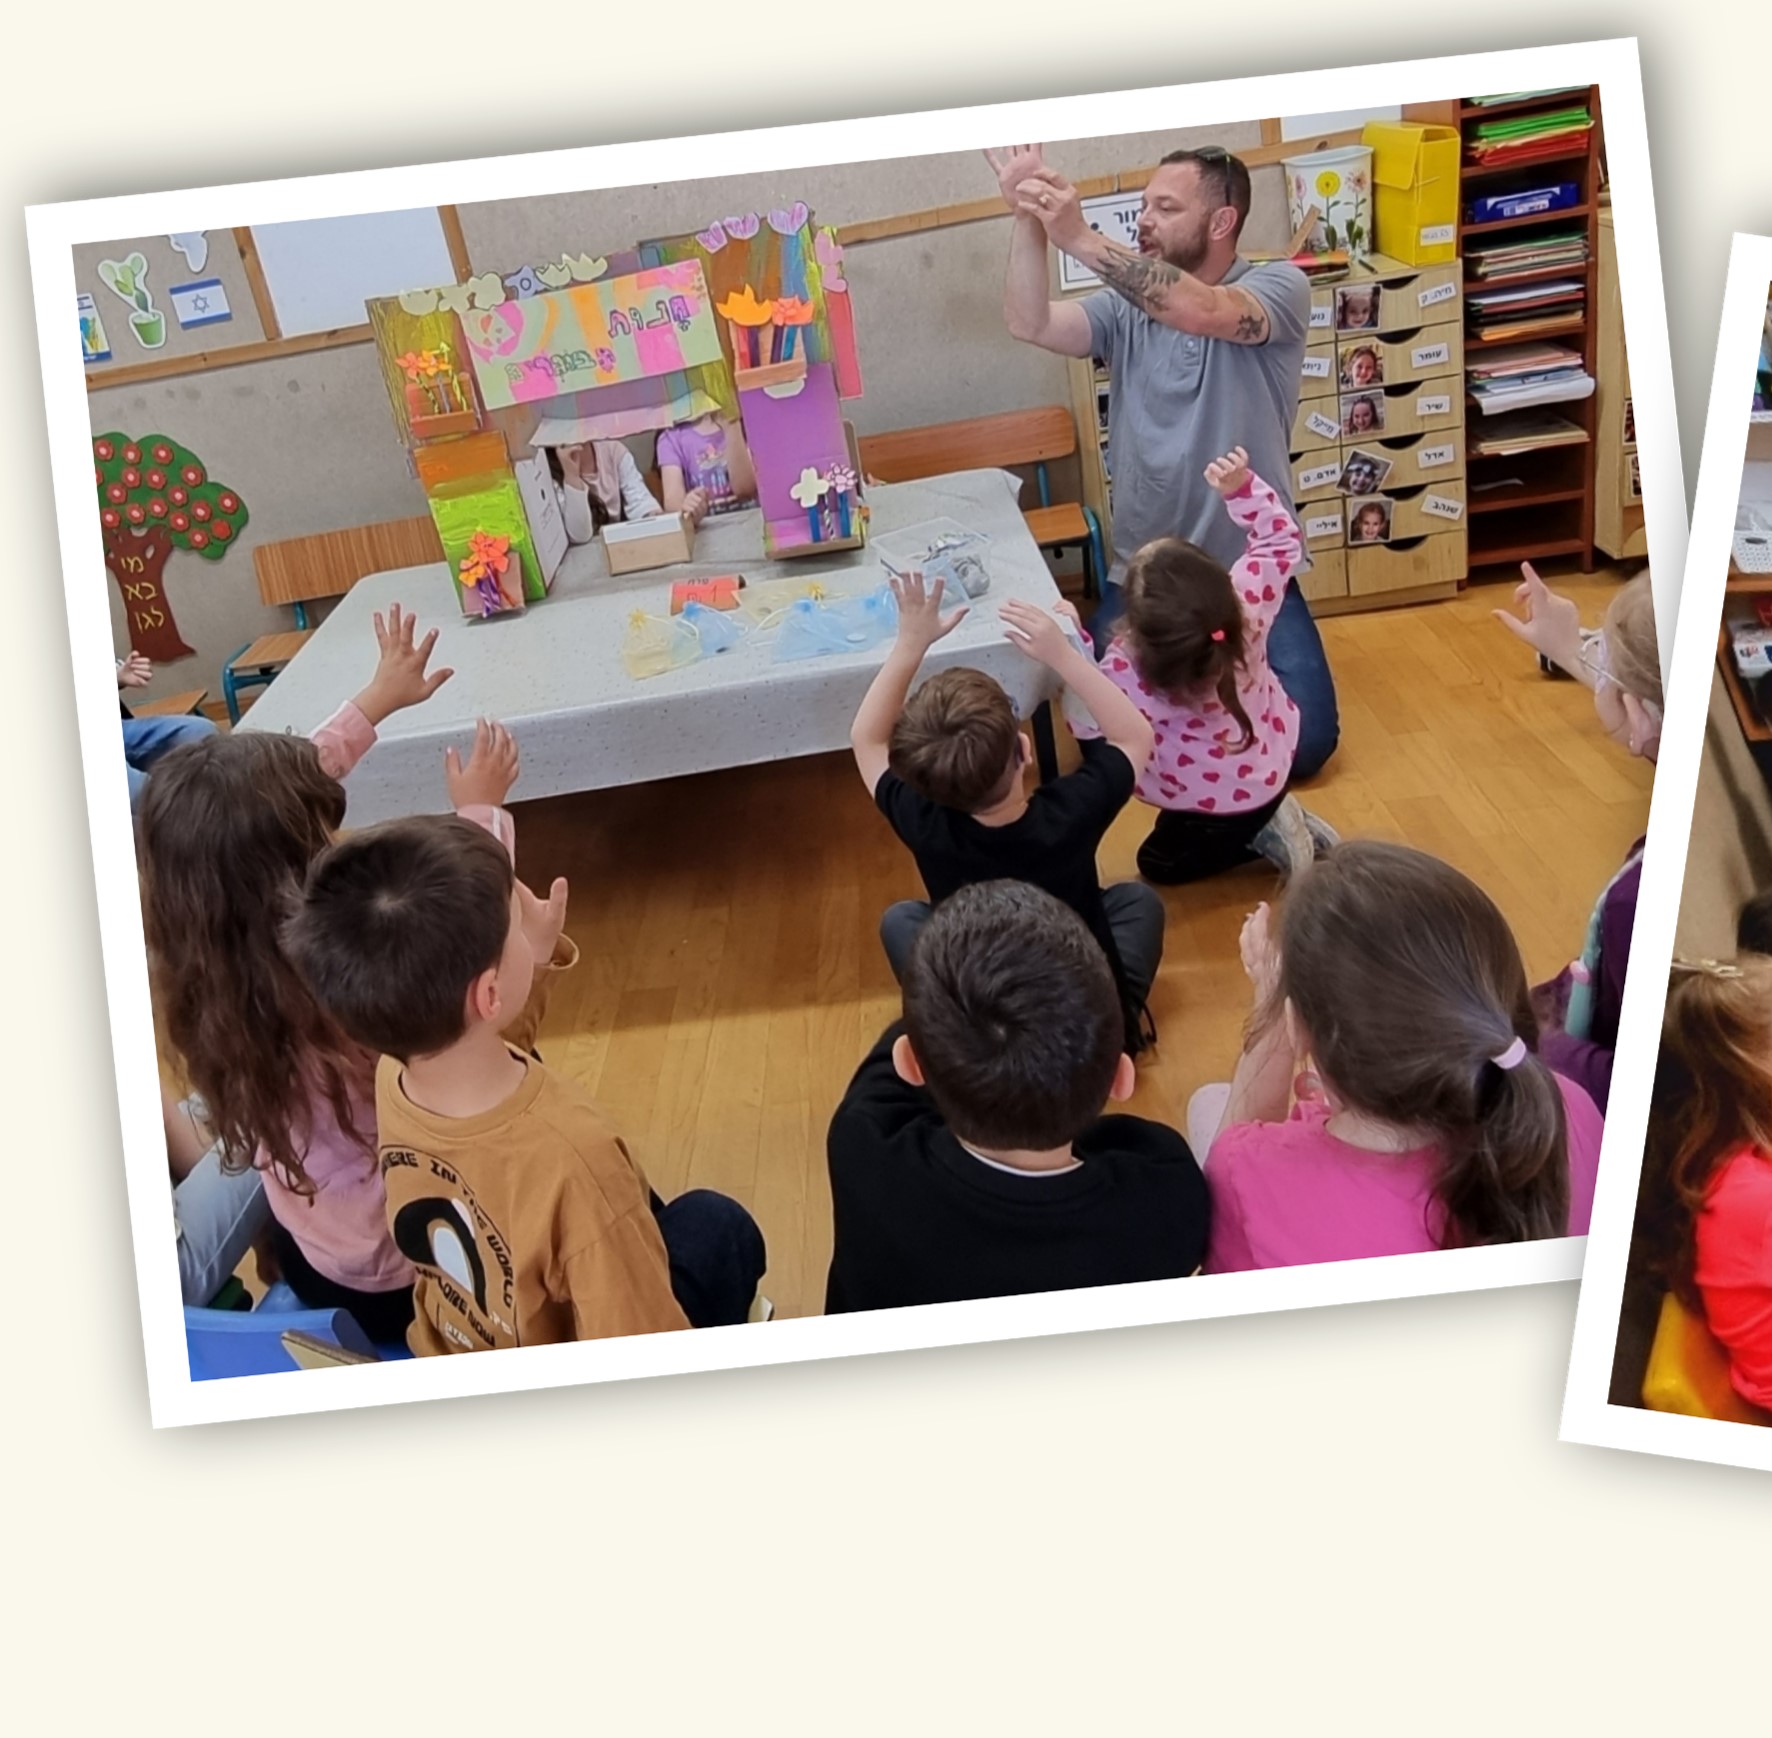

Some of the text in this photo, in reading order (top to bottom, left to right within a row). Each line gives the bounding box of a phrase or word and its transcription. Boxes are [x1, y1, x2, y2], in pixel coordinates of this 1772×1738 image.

[1418, 350, 1443, 361] עומר
[1425, 402, 1444, 412] שיר
[121, 556, 145, 573] מי
[125, 582, 159, 601] בא
[134, 605, 165, 634] לגן
[430, 1159, 457, 1184] IN
[468, 1309, 496, 1347] NOW
